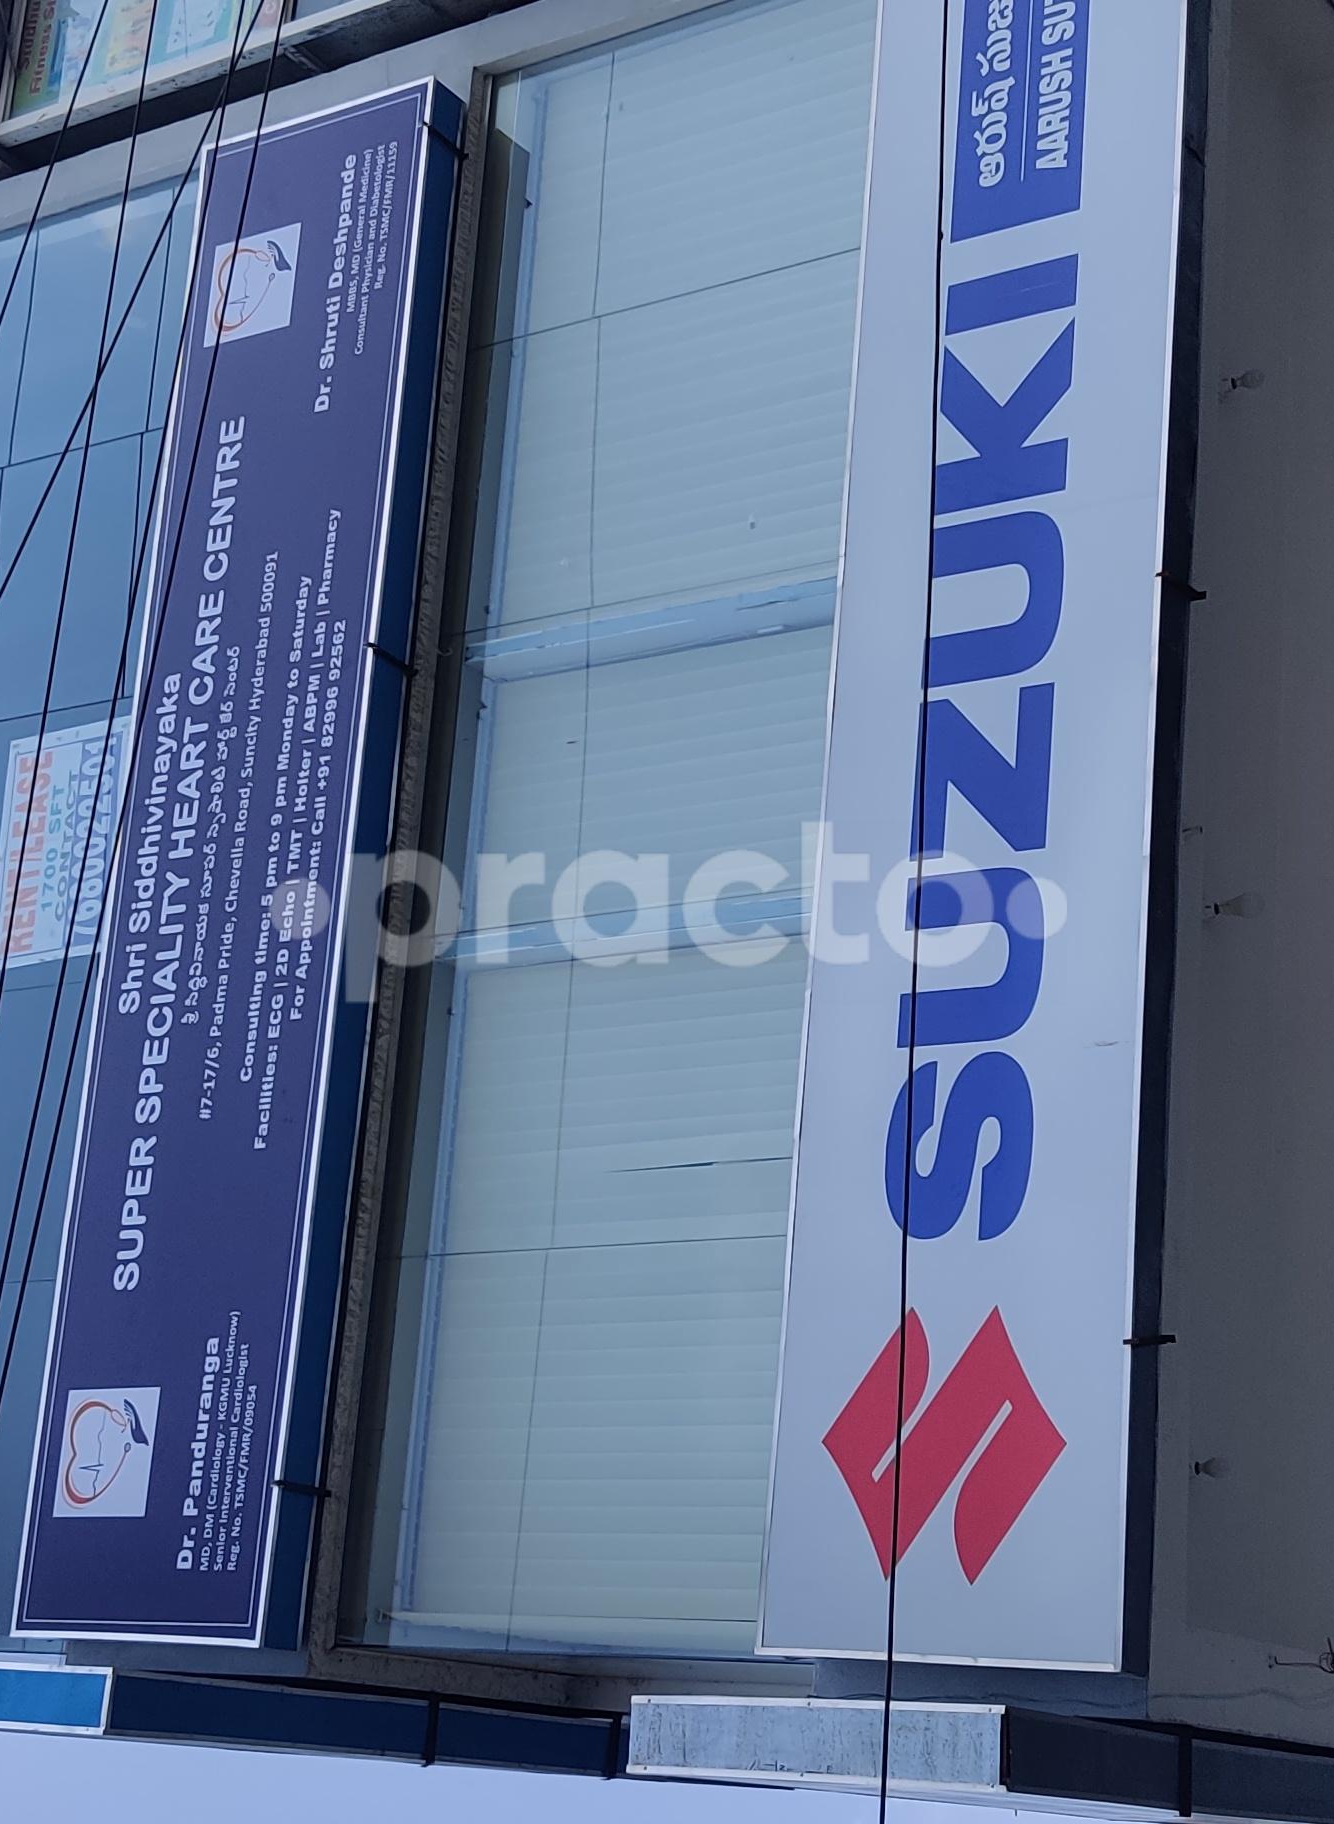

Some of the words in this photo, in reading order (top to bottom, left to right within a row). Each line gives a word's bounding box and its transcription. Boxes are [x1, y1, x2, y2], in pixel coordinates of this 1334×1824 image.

[1041, 0, 1076, 46] SU
[1034, 48, 1073, 169] AARUSH
[358, 148, 374, 203] Medicine)
[369, 144, 386, 218] Diabetologist
[327, 154, 357, 290] Deshpande
[352, 204, 366, 253] (General
[368, 218, 377, 240] and
[376, 242, 388, 263] No.
[350, 254, 361, 275] MD
[361, 241, 375, 293] Physician
[373, 263, 387, 290] Reg.
[319, 295, 341, 370] Shruti
[354, 294, 370, 355] Consultant
[313, 376, 332, 413] Dr.
[203, 416, 245, 582] CENTRE
[259, 551, 279, 613] 500091
[316, 509, 342, 606] Pharmacy
[188, 589, 225, 706] CARE
[289, 576, 312, 663] Saturday
[311, 621, 327, 658] Lab
[328, 619, 346, 681] 92562
[248, 616, 271, 711] Hyderabad
[286, 668, 300, 689] to
[276, 694, 299, 771] Monday
[303, 674, 321, 733] ABPM
[320, 686, 339, 748] 82996
[240, 715, 262, 778] Suncity
[317, 755, 332, 791] +91
[883, 252, 1079, 1241] SUZUKI
[48, 784, 64, 834] SFT
[128, 673, 181, 934] Siddhivinayaka
[167, 716, 209, 860] HEART
[234, 781, 254, 833] Road,
[274, 776, 288, 808] pm
[293, 749, 312, 812] Holter
[54, 769, 77, 922] CONTACT
[267, 831, 281, 853] to
[270, 813, 283, 826] 9
[311, 795, 327, 836] Call
[40, 847, 58, 911] 1700
[224, 837, 245, 913] Chevella
[265, 856, 278, 888] pm
[286, 829, 303, 875] TMT
[260, 894, 274, 906] 5
[278, 891, 296, 943] Echo
[295, 840, 322, 980] Appointment:
[217, 916, 238, 970] Pride,
[254, 912, 272, 965] time:
[275, 948, 289, 977] 2D
[118, 943, 148, 1014] Shri
[134, 871, 190, 1124] SPECIALITY
[209, 974, 229, 1037] Padma
[289, 984, 306, 1020] For
[240, 970, 268, 1082] Consulting
[267, 994, 284, 1039] ECG
[198, 1041, 223, 1119] #7-17/6,
[253, 1044, 279, 1149] Facilities:
[113, 1135, 158, 1291] SUPER
[222, 1311, 241, 1374] Lucknow)
[217, 1377, 231, 1421] KGMU
[230, 1343, 250, 1424] Cardiologist
[182, 1337, 221, 1516] Panduranga
[233, 1385, 258, 1510] TSMC/FMR/09054
[205, 1432, 226, 1510] (Cardiology
[218, 1426, 239, 1523] Interventional
[176, 1527, 197, 1570] Dr.
[203, 1513, 215, 1539] DM
[213, 1526, 227, 1571] Senior
[230, 1512, 243, 1537] No.
[199, 1542, 213, 1571] MD,
[226, 1540, 241, 1571] Reg.
